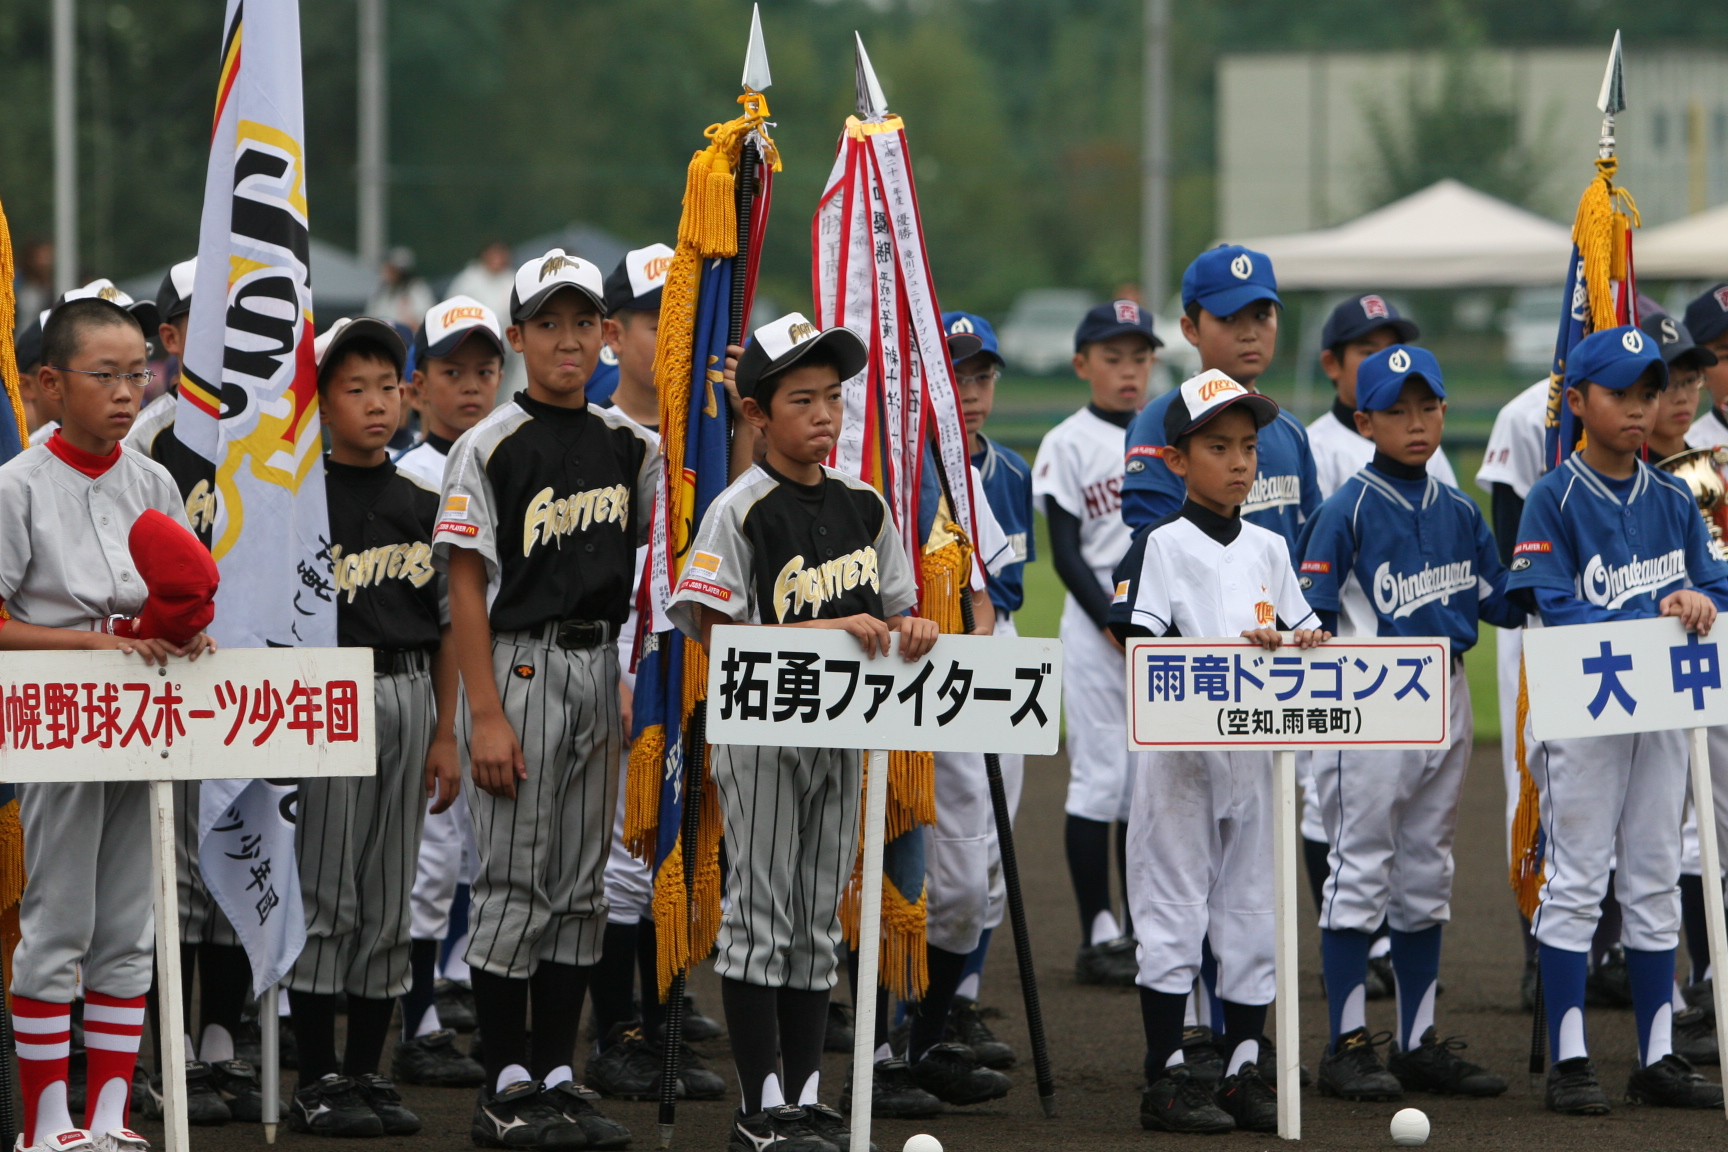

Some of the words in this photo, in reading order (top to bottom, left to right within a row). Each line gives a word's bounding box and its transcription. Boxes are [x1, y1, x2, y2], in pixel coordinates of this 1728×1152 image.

[1660, 317, 1680, 345] S
[719, 647, 1052, 729] 拓勇ファイターズ
[1147, 653, 1433, 703] 雨竜ドラゴンズ
[0, 679, 359, 751] 幌野球スポーツ少年団
